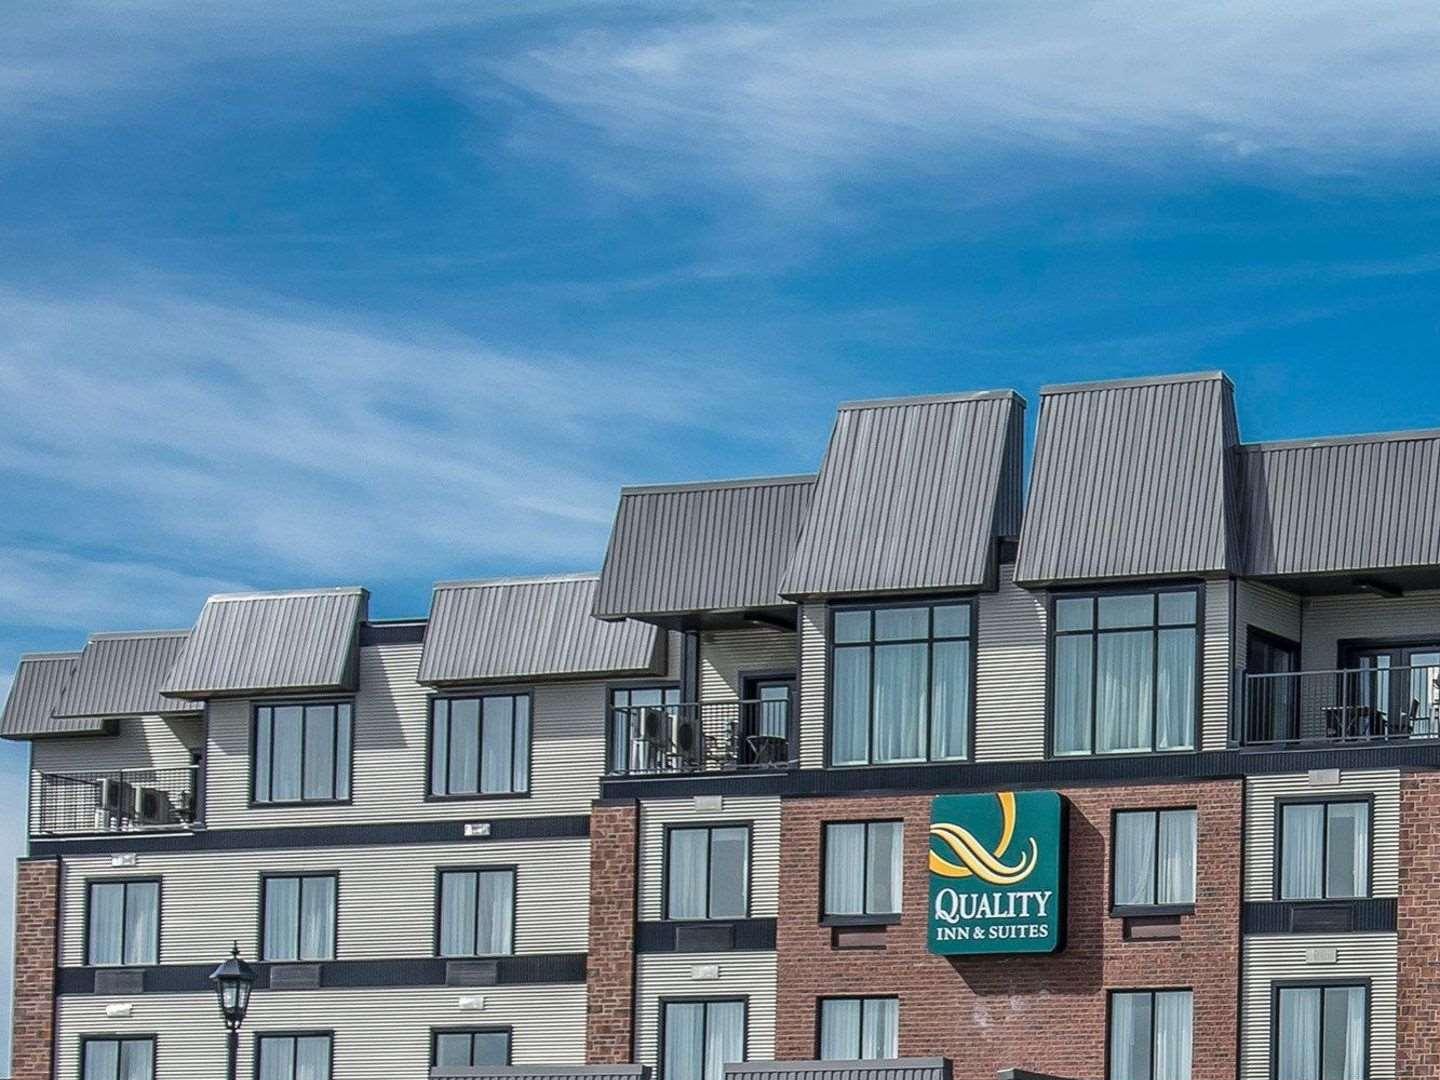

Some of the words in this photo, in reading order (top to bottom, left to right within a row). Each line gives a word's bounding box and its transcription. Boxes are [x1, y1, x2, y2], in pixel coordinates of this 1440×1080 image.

[935, 888, 1052, 924] QUALITY
[936, 927, 969, 941] INN
[973, 926, 985, 940] &
[989, 924, 1049, 939] SUITES
